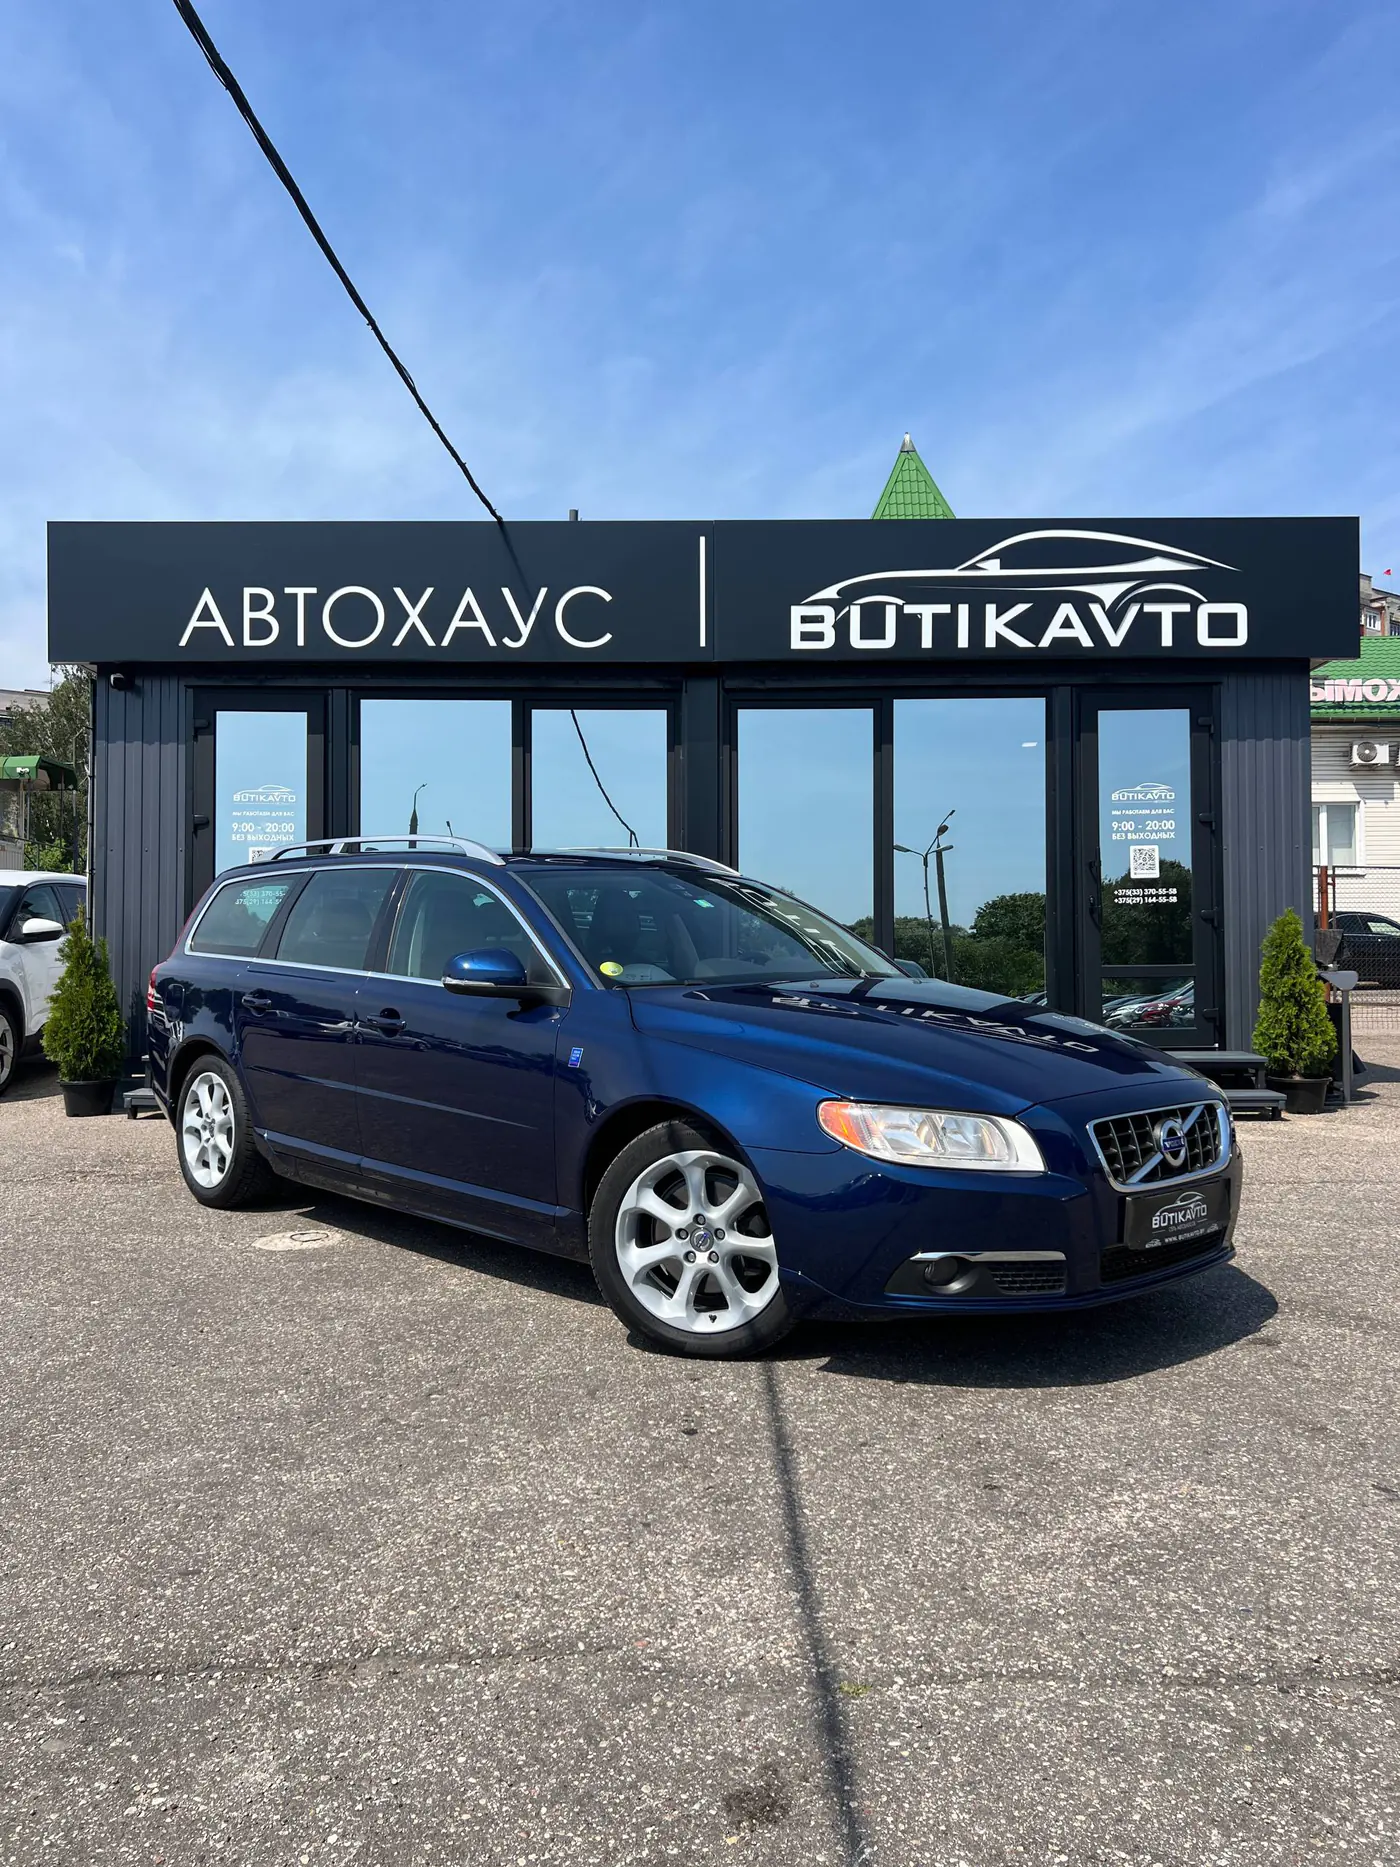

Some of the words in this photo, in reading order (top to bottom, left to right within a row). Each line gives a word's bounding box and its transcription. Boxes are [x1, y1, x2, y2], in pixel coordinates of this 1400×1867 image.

[179, 586, 614, 648] АВТОХАУС
[790, 602, 1249, 650] BUTIKAVTO
[233, 793, 296, 802] BUTIKAVTO
[1111, 792, 1175, 801] BUTIKAVTO
[232, 822, 255, 833] 9:00
[265, 822, 295, 833] 20:00
[1111, 821, 1135, 831] 9:00
[1145, 820, 1175, 830] 20:00
[232, 833, 245, 841] БЕЗ
[247, 833, 295, 842] ВЫХОДНЫХ
[1112, 832, 1126, 840] БЕЗ
[1127, 832, 1176, 840] ВЫХОДНЫХ
[1113, 888, 1143, 896] +375(33)
[1113, 896, 1143, 904] +375(29)
[1152, 1204, 1207, 1229] BUTIKAVTO
